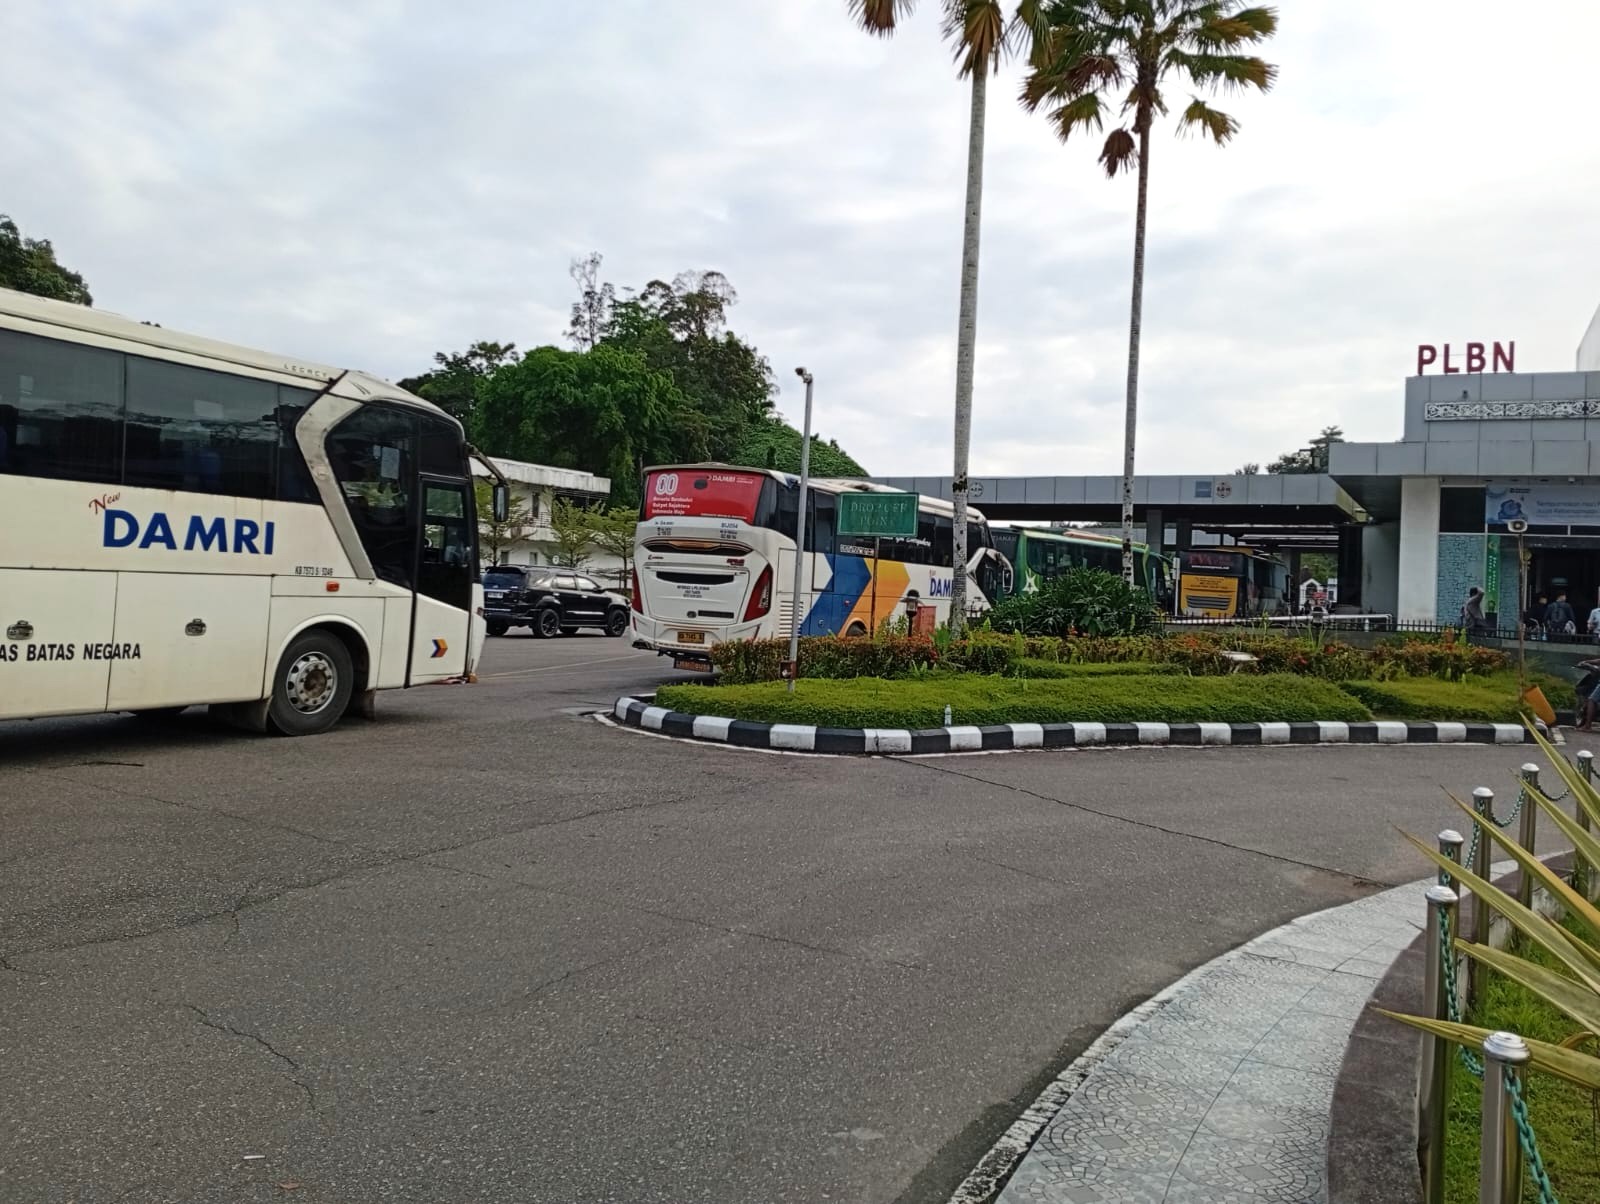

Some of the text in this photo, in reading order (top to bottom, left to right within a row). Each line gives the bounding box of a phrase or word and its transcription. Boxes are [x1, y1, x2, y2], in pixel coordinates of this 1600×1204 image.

[1418, 341, 1515, 376] PLBN
[89, 492, 121, 515] New
[103, 509, 275, 555] DAMRI
[26, 643, 75, 661] BATAS
[83, 643, 141, 660] NEGARA
